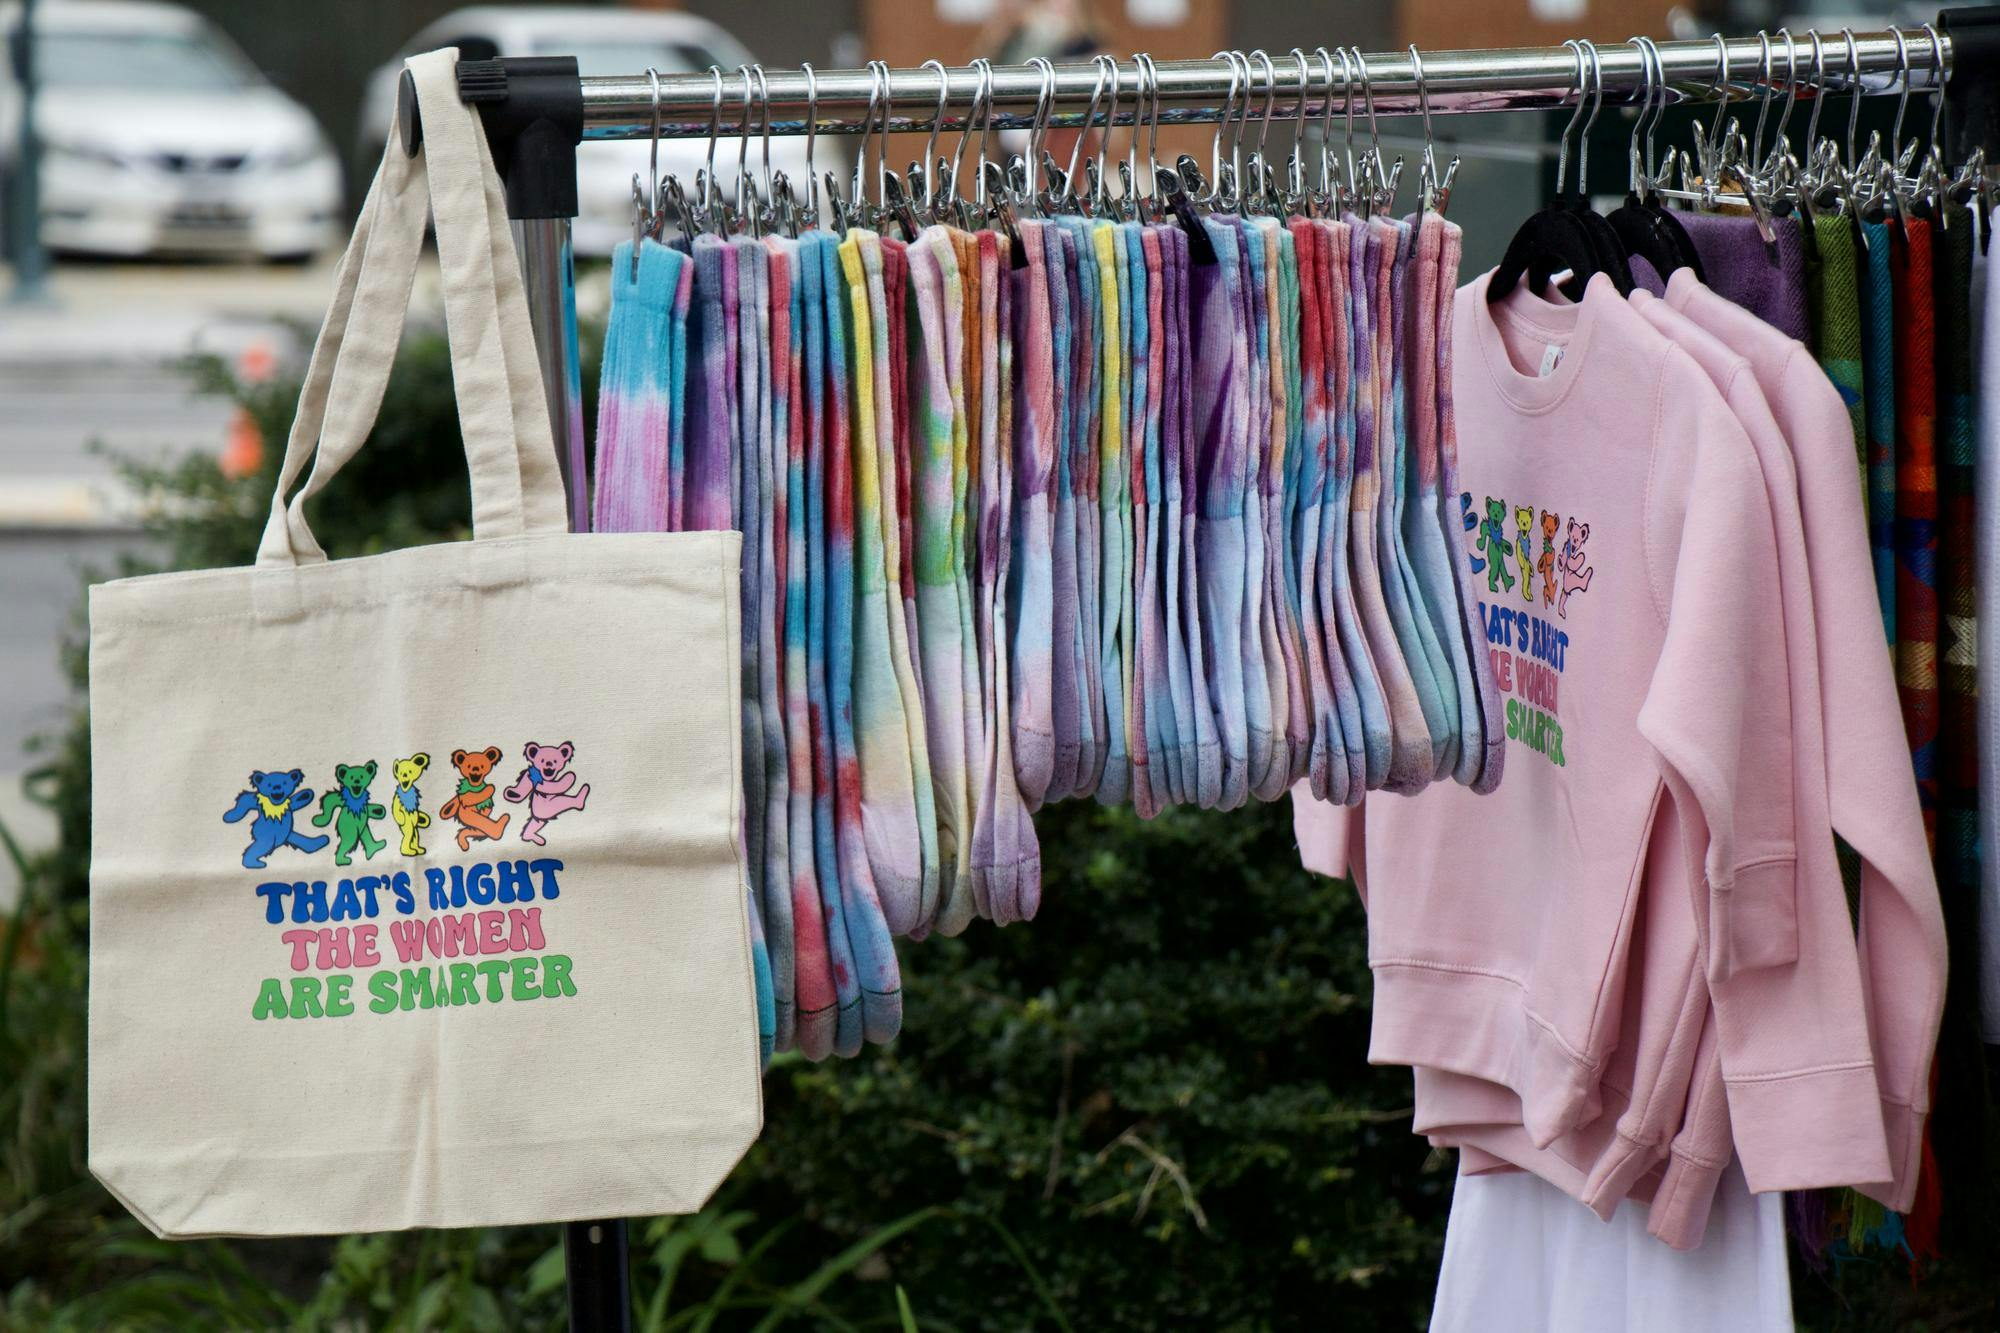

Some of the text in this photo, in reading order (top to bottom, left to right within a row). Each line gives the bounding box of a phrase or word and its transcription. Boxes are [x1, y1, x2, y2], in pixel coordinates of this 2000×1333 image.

[256, 858, 564, 924] THAT'S RIGHT
[281, 907, 546, 972] THE WOMEN
[252, 954, 578, 1020] ARE SMARTER
